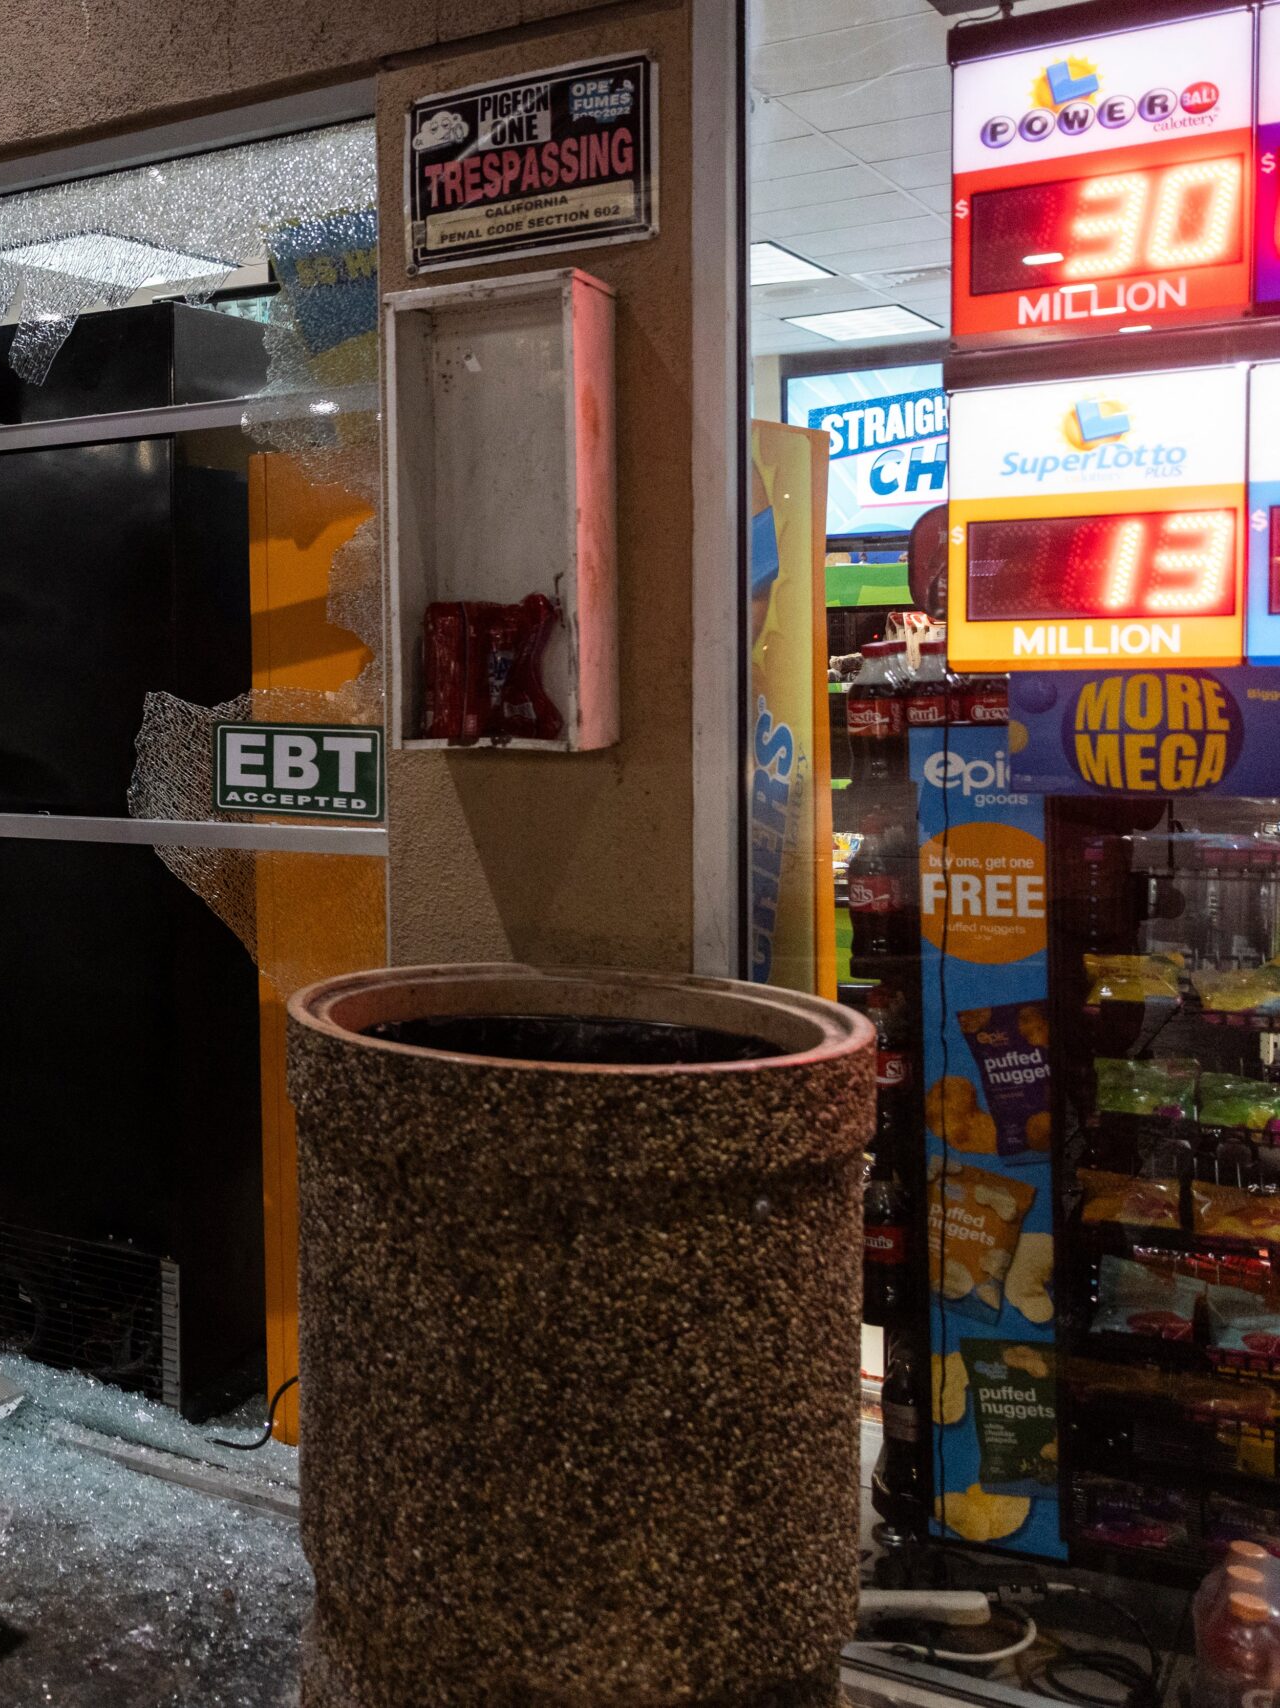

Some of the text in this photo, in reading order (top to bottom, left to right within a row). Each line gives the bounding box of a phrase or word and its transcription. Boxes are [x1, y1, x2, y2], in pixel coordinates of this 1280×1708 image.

[479, 84, 550, 123] PIGEON
[490, 114, 539, 147] ONE
[424, 127, 634, 208] TRESPASSING
[1260, 152, 1275, 173] $
[440, 205, 620, 244] PENAL CODE SECTION 602
[485, 195, 568, 219] CALIFORNIA
[954, 158, 1241, 278] $ 30
[1017, 277, 1188, 326] MILLION
[1000, 443, 1187, 482] SuperLotto
[1250, 509, 1268, 532] $
[950, 510, 1235, 614] $ 13
[1013, 623, 1181, 655] MILLION
[1074, 673, 1231, 731] MORE
[225, 732, 372, 793] EBT
[923, 751, 1009, 796] epi
[1074, 733, 1228, 792] MEGA
[225, 791, 367, 810] ACCEPTED
[974, 792, 1028, 808] goods
[929, 855, 1035, 871] buy one, get one
[921, 873, 1046, 918] FREE
[943, 921, 977, 933] uffed
[984, 1047, 1043, 1073] puffed
[978, 1385, 1037, 1403] puffed
[980, 1402, 1057, 1420] nuggets
